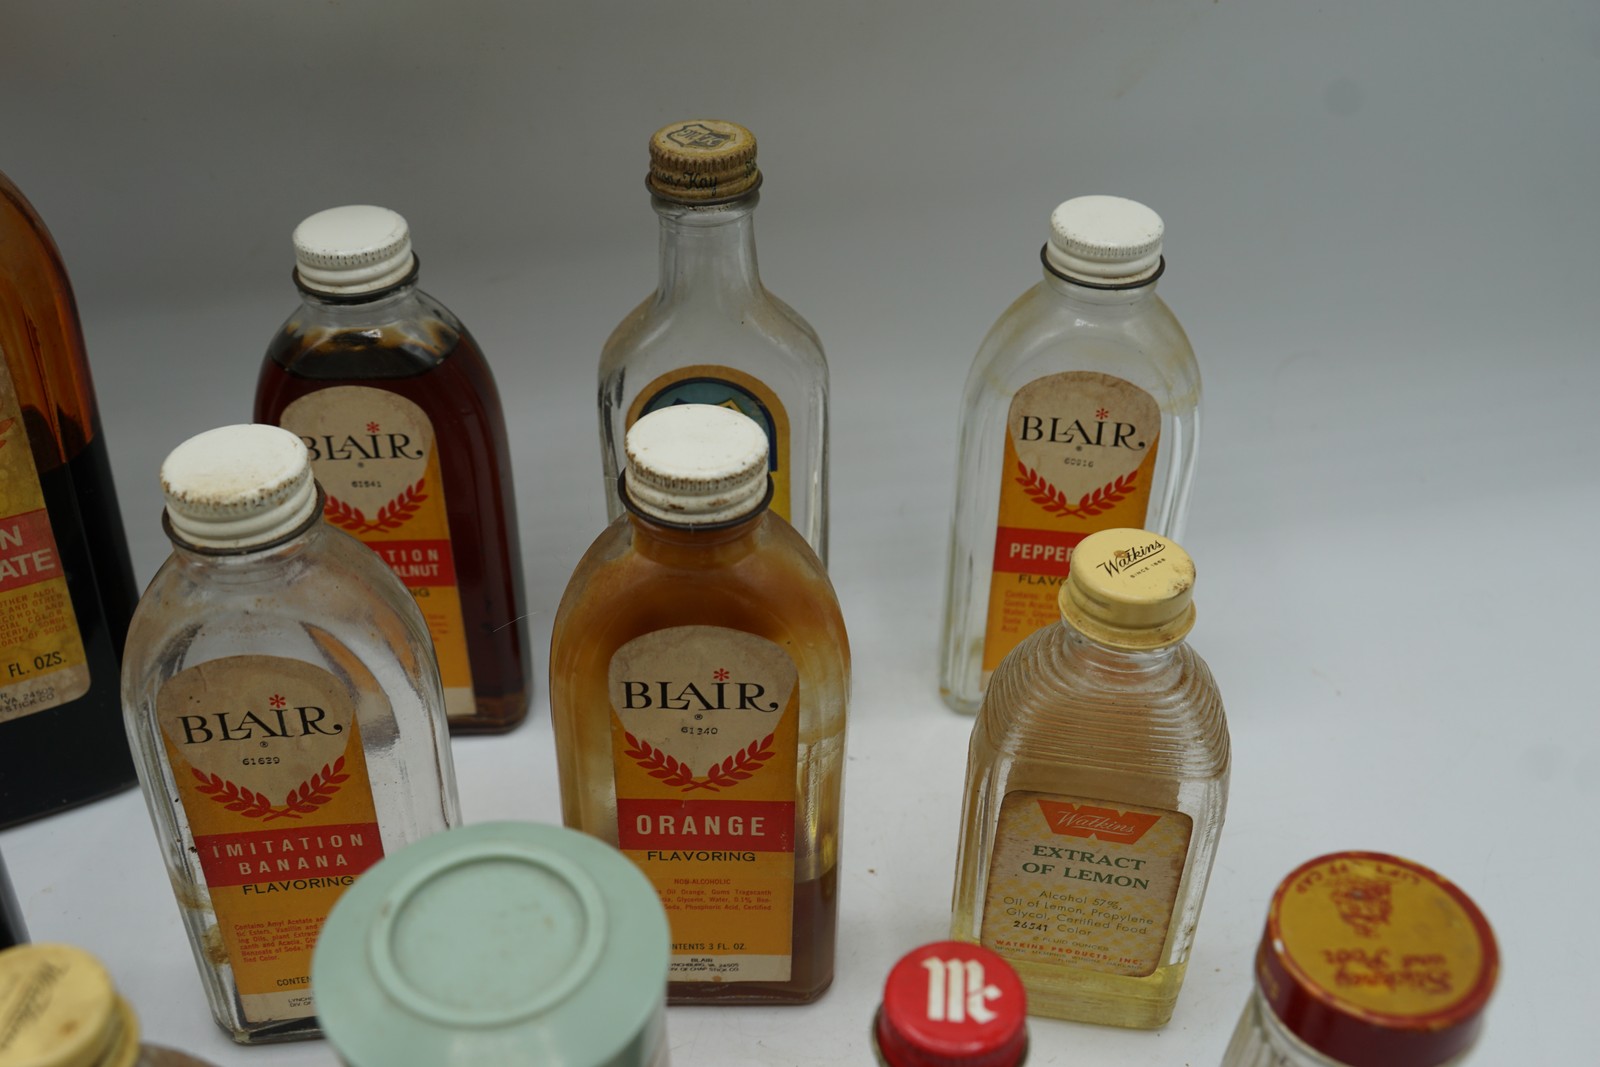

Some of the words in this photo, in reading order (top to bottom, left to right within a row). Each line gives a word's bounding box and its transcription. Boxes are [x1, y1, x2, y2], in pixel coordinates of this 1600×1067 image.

[398, 563, 440, 577] ALNUT
[1096, 540, 1166, 578] Watkins
[8, 662, 31, 678] FL.
[34, 651, 67, 671] OZS.
[636, 814, 766, 836] ORANGE
[1055, 810, 1136, 836] Watkins
[213, 833, 364, 858] IMITATION
[647, 851, 756, 861] FLAVORING
[1033, 844, 1147, 871] EXTRACT
[239, 853, 348, 876] BANANA
[1022, 862, 1056, 875] OF
[1064, 866, 1150, 890] LEMON
[243, 875, 355, 895] FLAVORING
[1003, 896, 1022, 906] Oil
[1027, 898, 1040, 908] of
[1044, 901, 1086, 916] Lemon,
[1091, 908, 1154, 926] Propylene
[1039, 890, 1088, 905] Alcohol
[1092, 898, 1123, 911] 57%,
[1006, 907, 1050, 921] Glycol,
[1056, 913, 1110, 929] Certified
[1116, 922, 1148, 935] Food
[1013, 920, 1049, 932] 26541
[1057, 924, 1093, 937] Color
[995, 940, 1045, 951] WATKINS
